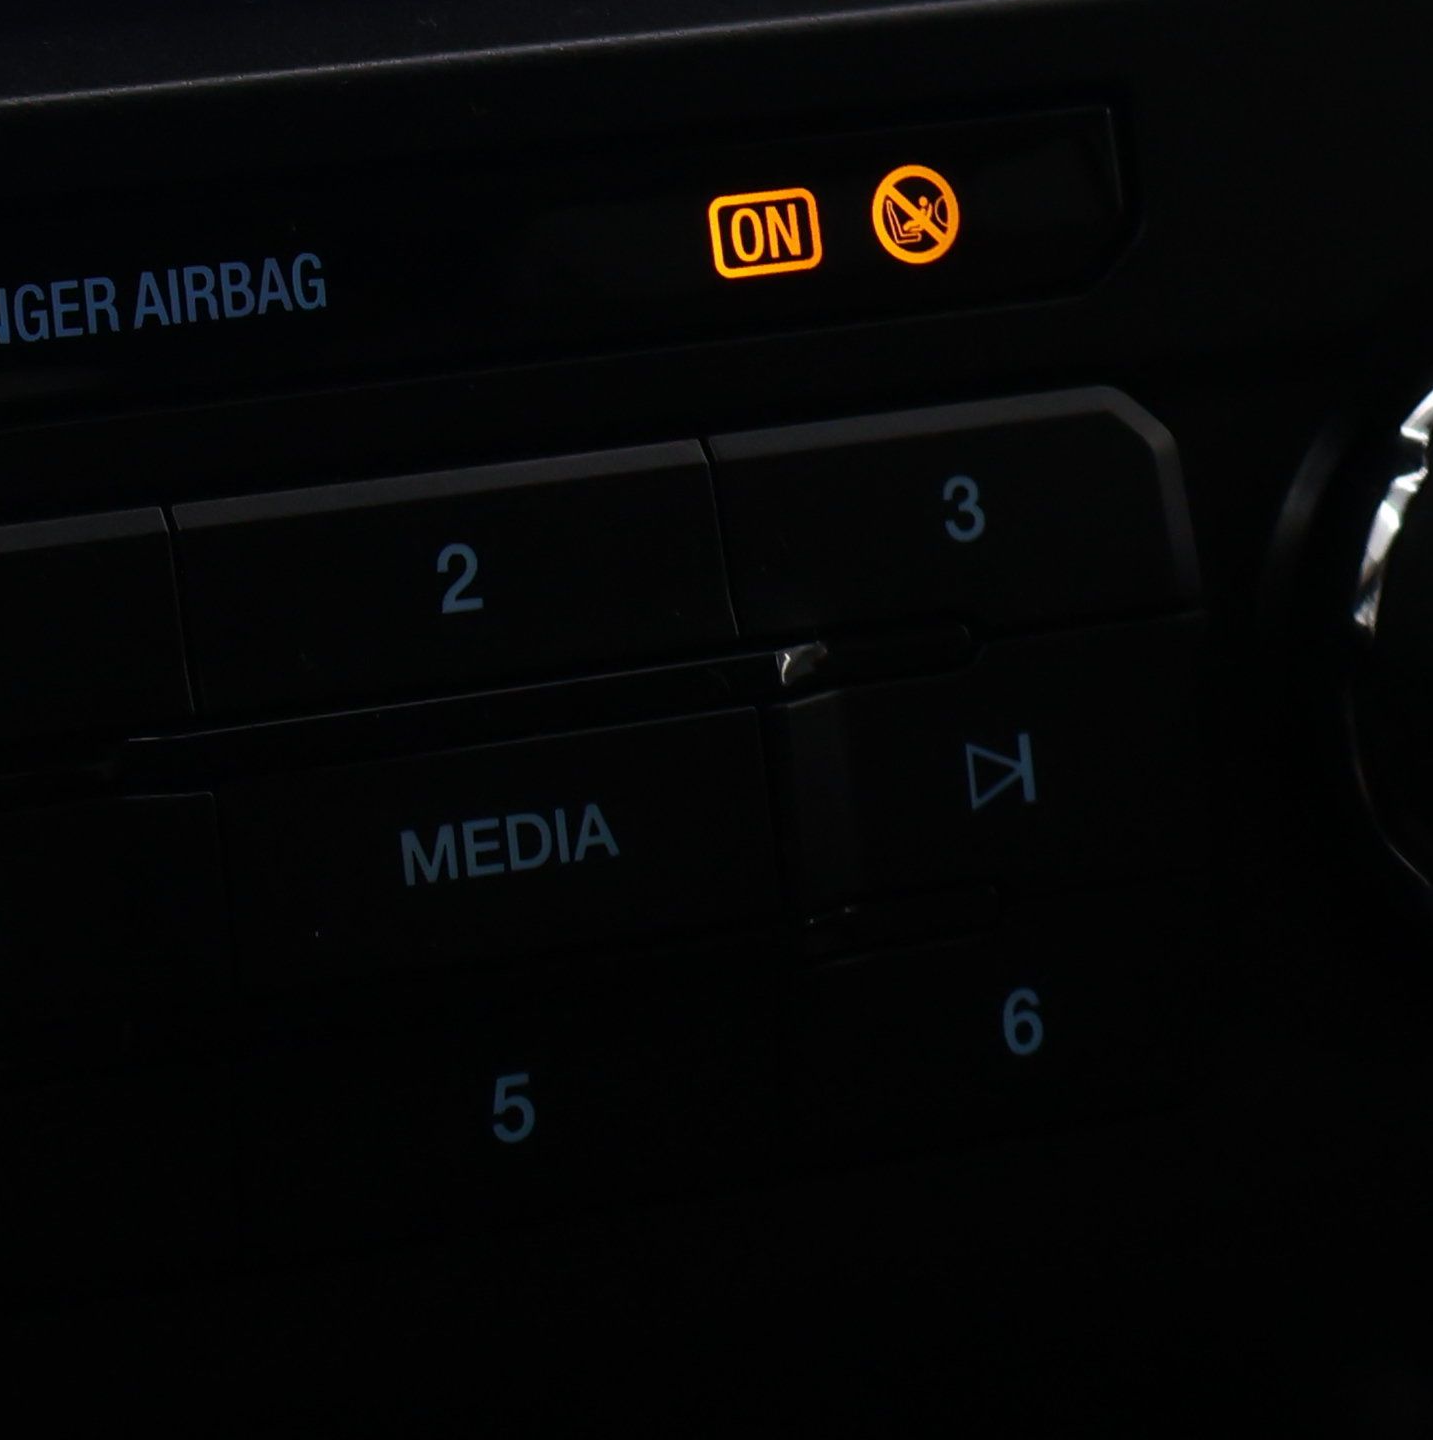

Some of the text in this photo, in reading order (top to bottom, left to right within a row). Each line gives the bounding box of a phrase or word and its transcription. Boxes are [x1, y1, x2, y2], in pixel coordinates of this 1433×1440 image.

[729, 201, 803, 263] ON
[134, 253, 326, 328] AIRBAG
[943, 475, 985, 541] 3
[437, 543, 483, 613] 2
[400, 803, 619, 885] MEDIA
[1003, 988, 1043, 1055] 6
[493, 1072, 535, 1142] 5
